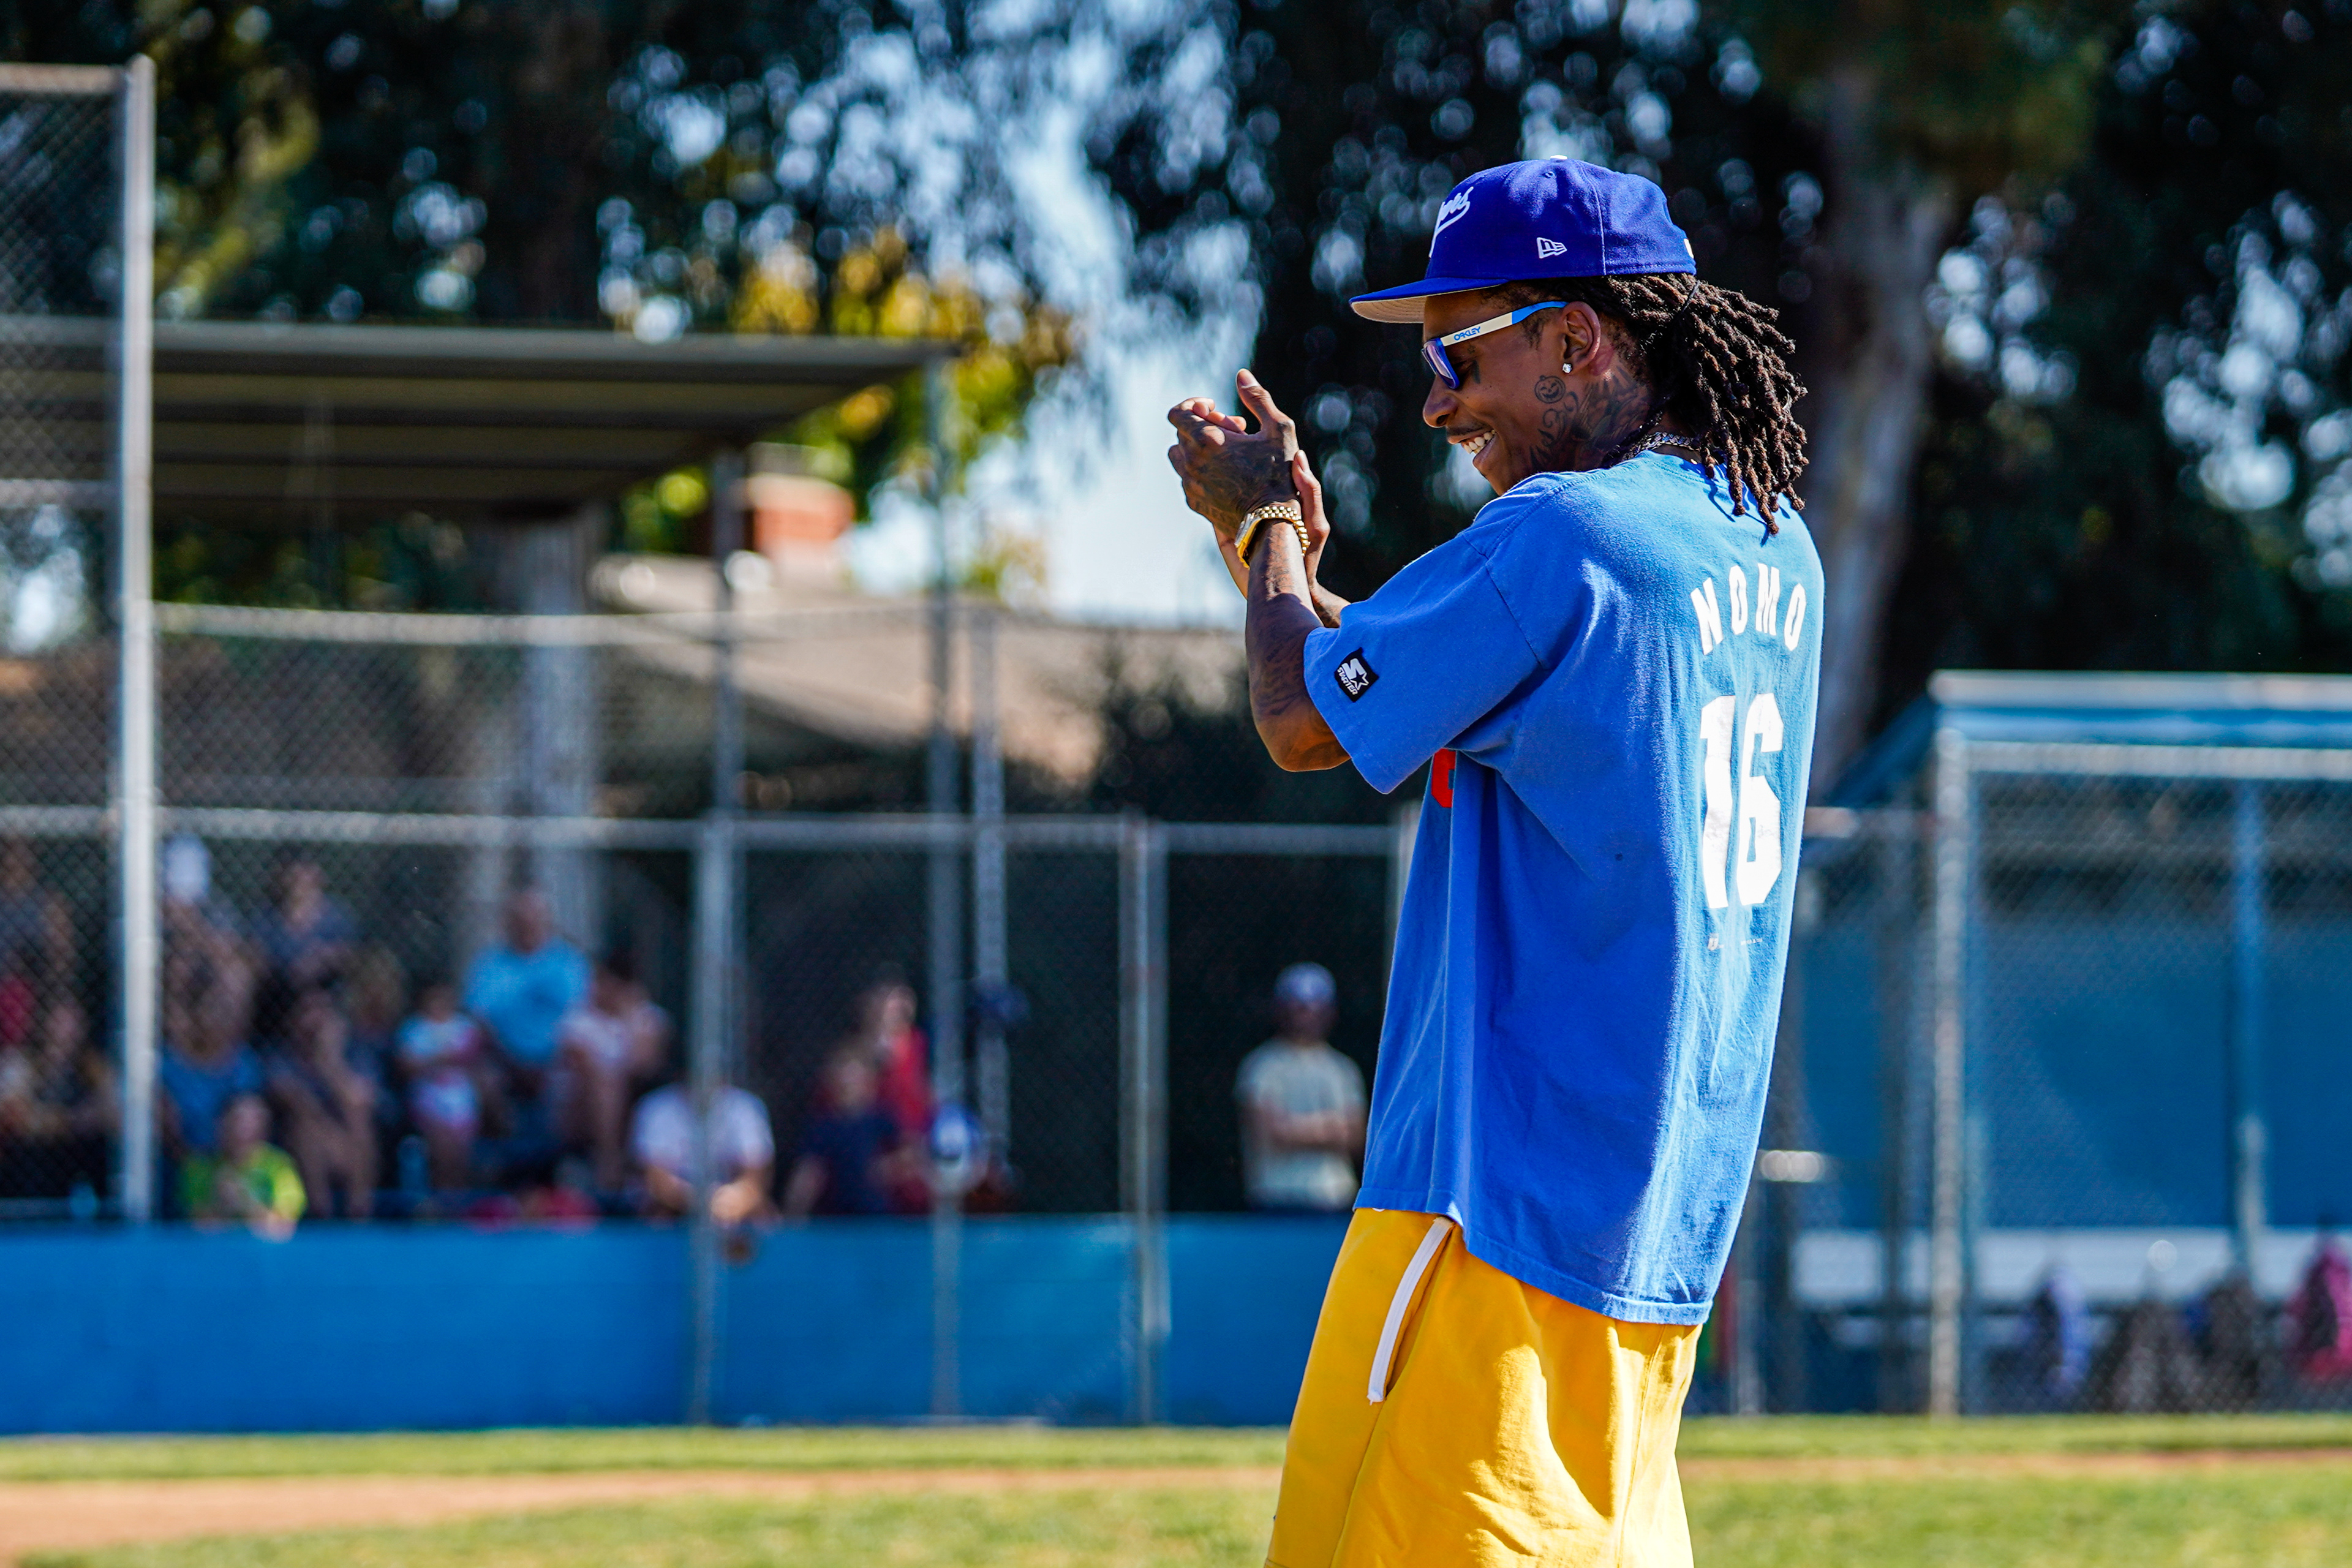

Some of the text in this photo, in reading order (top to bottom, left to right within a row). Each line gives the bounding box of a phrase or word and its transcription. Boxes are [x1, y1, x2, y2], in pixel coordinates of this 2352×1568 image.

[1453, 326, 1480, 341] OAKLEY
[1690, 563, 1806, 655] NOMO
[1337, 667, 1358, 695] STARTER
[1700, 693, 1784, 909] 16
